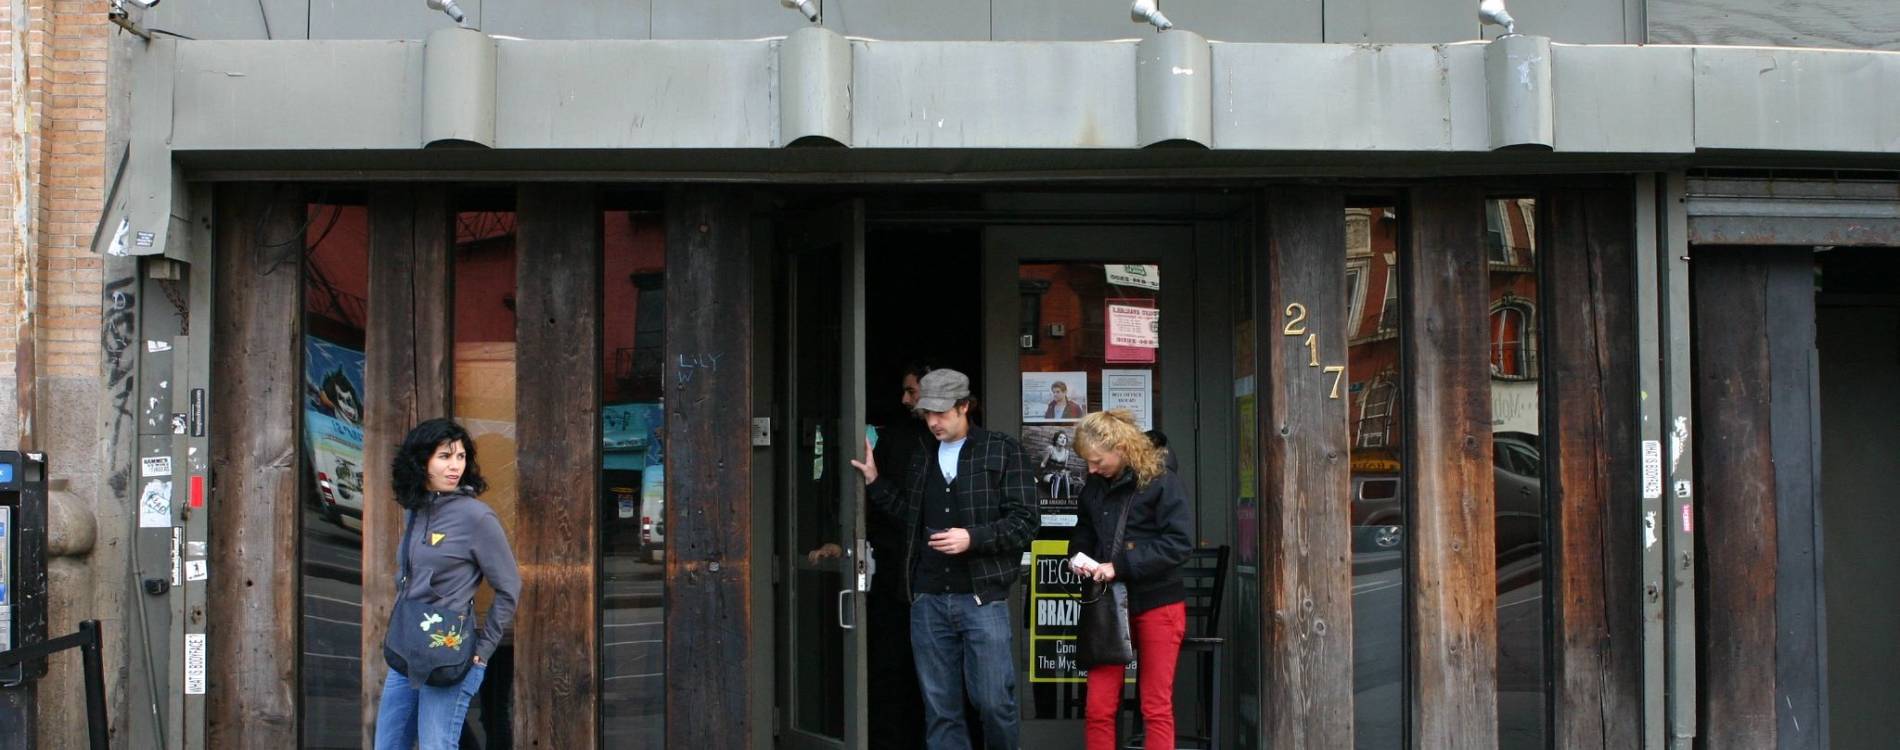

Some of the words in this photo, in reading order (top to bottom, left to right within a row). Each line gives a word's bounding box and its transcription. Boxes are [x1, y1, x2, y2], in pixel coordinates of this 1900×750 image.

[1284, 303, 1344, 398] 217
[1037, 559, 1081, 584] TEGA
[1037, 599, 1081, 626] BRAZI
[1056, 640, 1077, 654] Con
[1037, 655, 1056, 669] The
[1058, 655, 1077, 672] Mys
